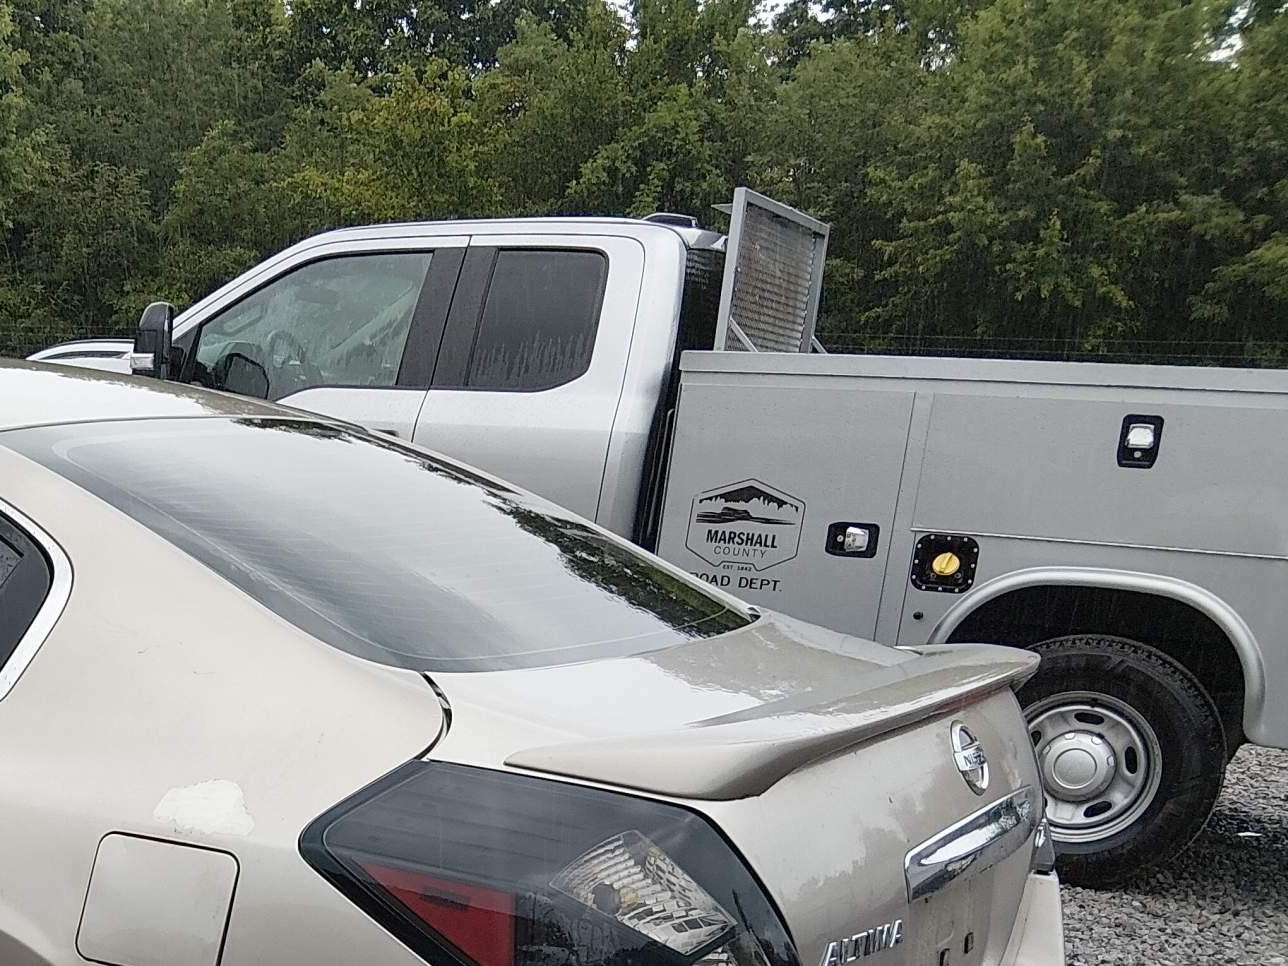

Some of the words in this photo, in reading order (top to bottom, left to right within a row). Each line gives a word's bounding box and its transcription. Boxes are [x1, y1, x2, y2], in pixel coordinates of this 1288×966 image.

[706, 529, 778, 548] MARSHALL
[713, 546, 767, 558] COUNTY
[738, 576, 782, 592] DEPT.
